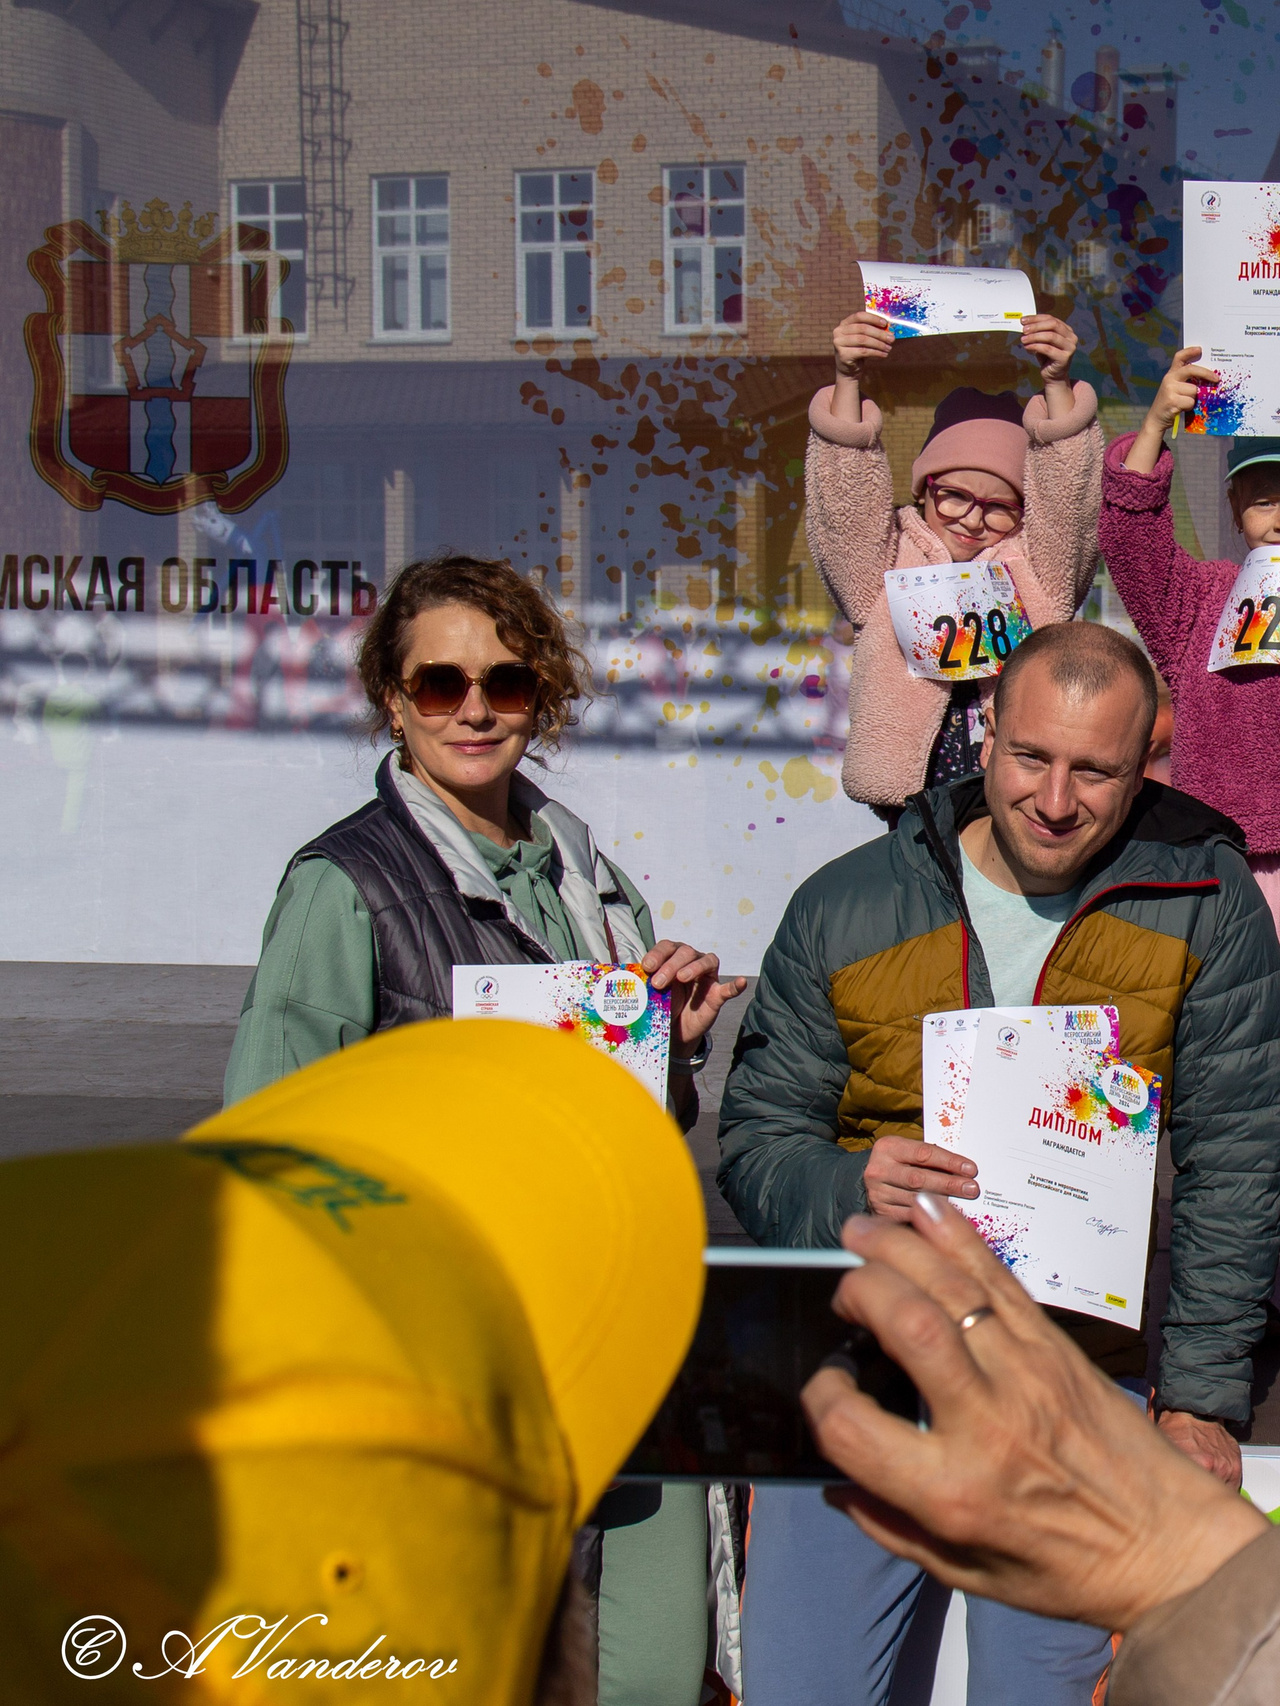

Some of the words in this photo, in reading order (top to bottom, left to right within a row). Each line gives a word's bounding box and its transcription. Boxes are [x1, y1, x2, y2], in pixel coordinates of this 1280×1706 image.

[161, 556, 378, 616] ОБЛАСТЬ
[933, 609, 1012, 669] 228
[1028, 1107, 1102, 1146] ДИПЛОМ
[1042, 1138, 1086, 1157] НАГРАЖДАЕТСЯ
